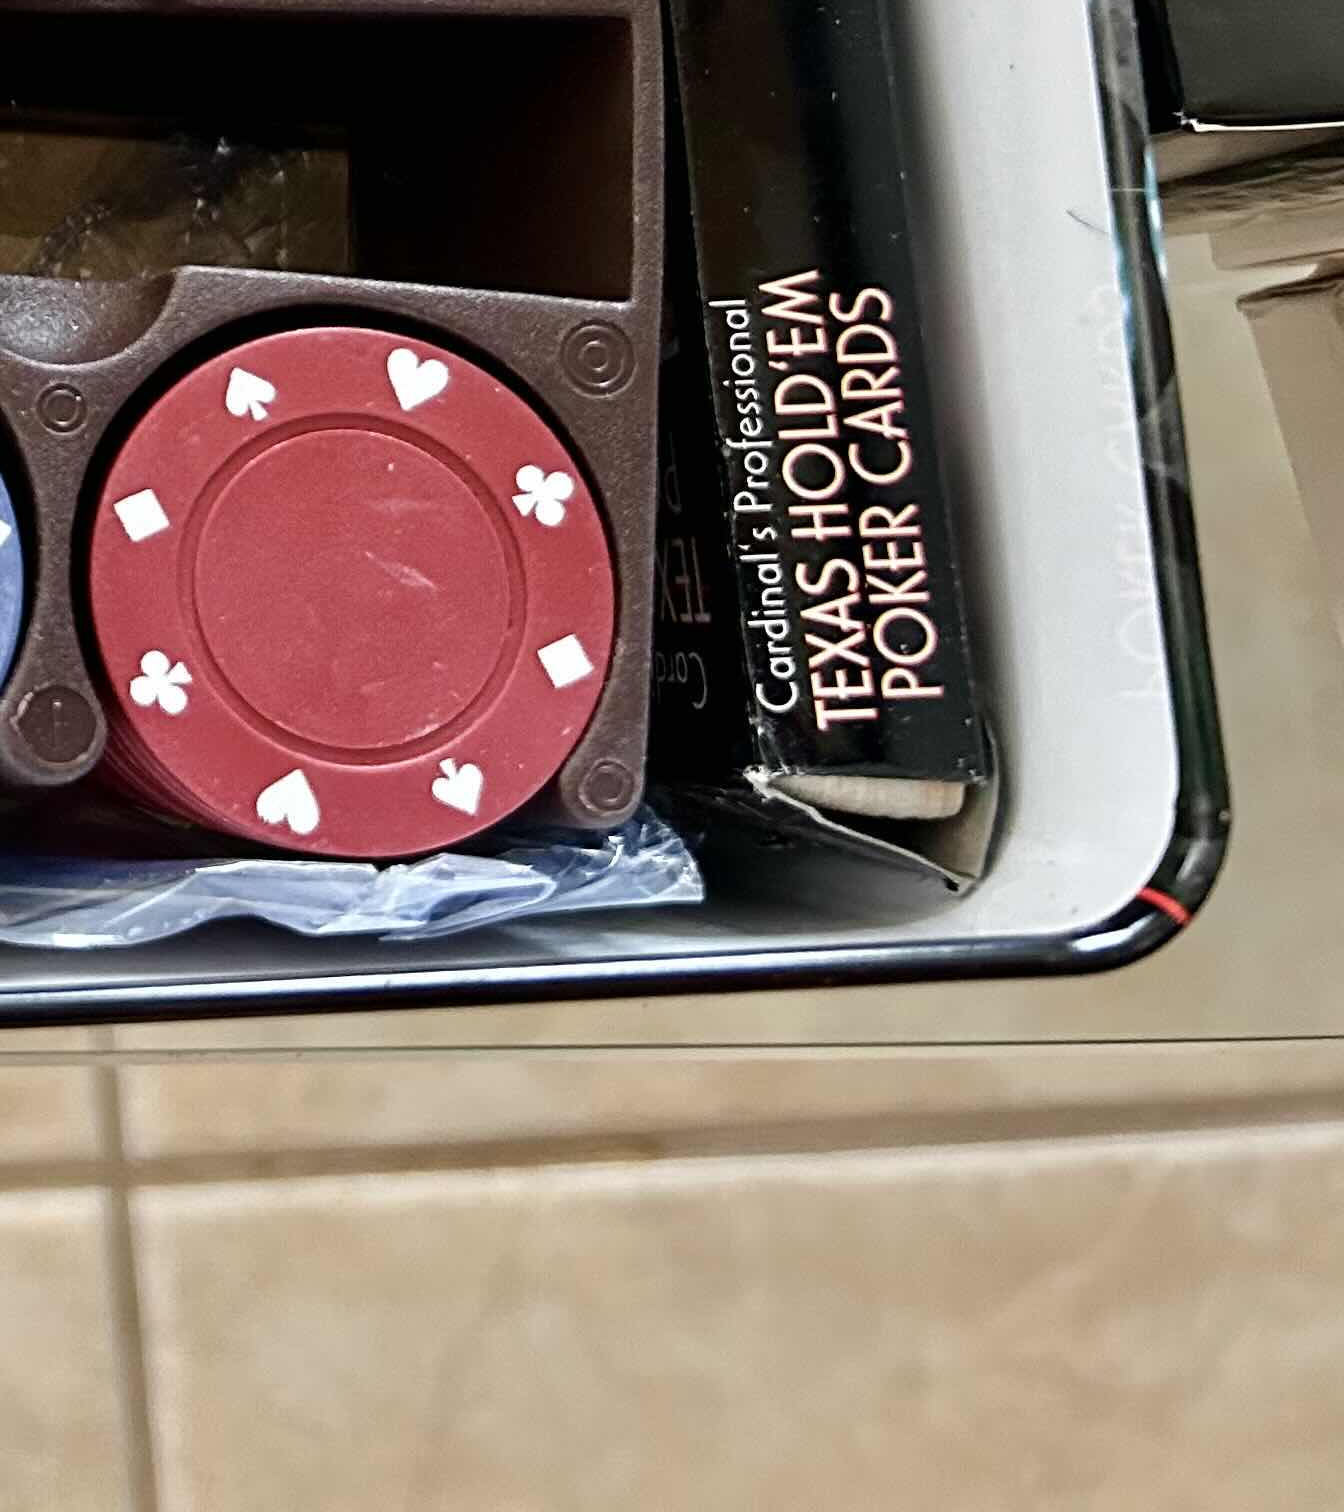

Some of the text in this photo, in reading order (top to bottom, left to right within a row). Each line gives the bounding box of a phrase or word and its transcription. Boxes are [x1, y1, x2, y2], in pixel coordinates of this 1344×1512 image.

[708, 299, 800, 715] Cardinal's Professional
[758, 268, 879, 733] TEXAS HOLD'EM
[829, 287, 945, 701] POKER CARDS
